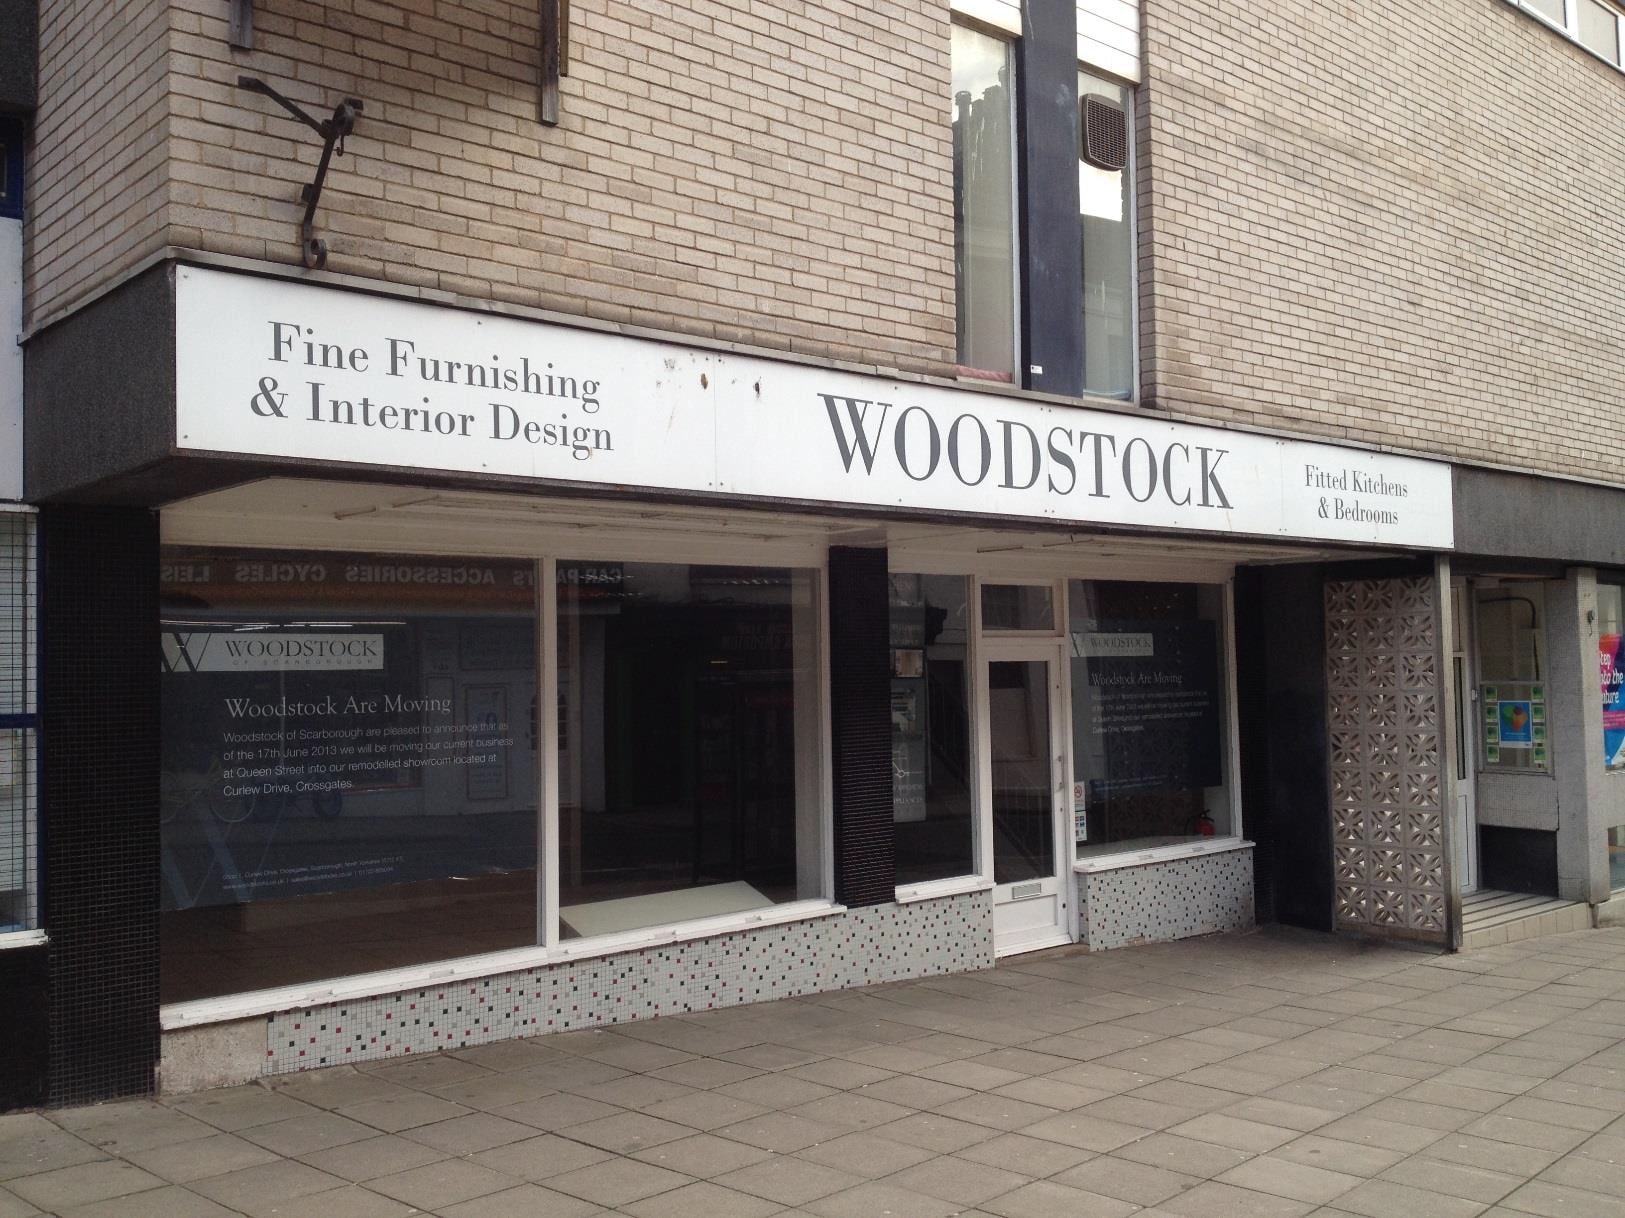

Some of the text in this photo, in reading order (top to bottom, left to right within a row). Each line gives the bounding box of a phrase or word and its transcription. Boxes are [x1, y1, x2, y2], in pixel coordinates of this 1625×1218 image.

[267, 320, 601, 415] Fine Furnishing
[249, 375, 615, 461] & Interior Design
[816, 392, 1234, 510] WOODSTOCK
[1304, 464, 1409, 498] Fitted Kitchens
[1317, 496, 1399, 525] & Bedrooms
[225, 639, 378, 657] WOODSTOCK
[1089, 637, 1152, 649] WOODSTOCK
[1600, 651, 1611, 669] tep
[1612, 668, 1624, 685] the
[223, 693, 452, 718] Woodstock Are Moving
[223, 730, 284, 744] Woodstock
[286, 730, 297, 741] of
[299, 727, 364, 740] Scarborough
[365, 727, 381, 738] are
[383, 724, 420, 738] pleased
[422, 724, 433, 734] to
[223, 750, 235, 761] of
[237, 749, 255, 761] the
[257, 747, 280, 760] 17th
[282, 747, 309, 759] June
[311, 745, 337, 757] 2013
[339, 747, 355, 756] we
[357, 743, 373, 754] will
[374, 742, 388, 753] be
[389, 741, 424, 755] moving
[425, 741, 441, 751] our
[475, 736, 514, 748] business
[223, 753, 497, 779] at Queen Street into our remodelled showroom located at
[223, 784, 261, 797] Curlew
[263, 783, 293, 795] Drive,
